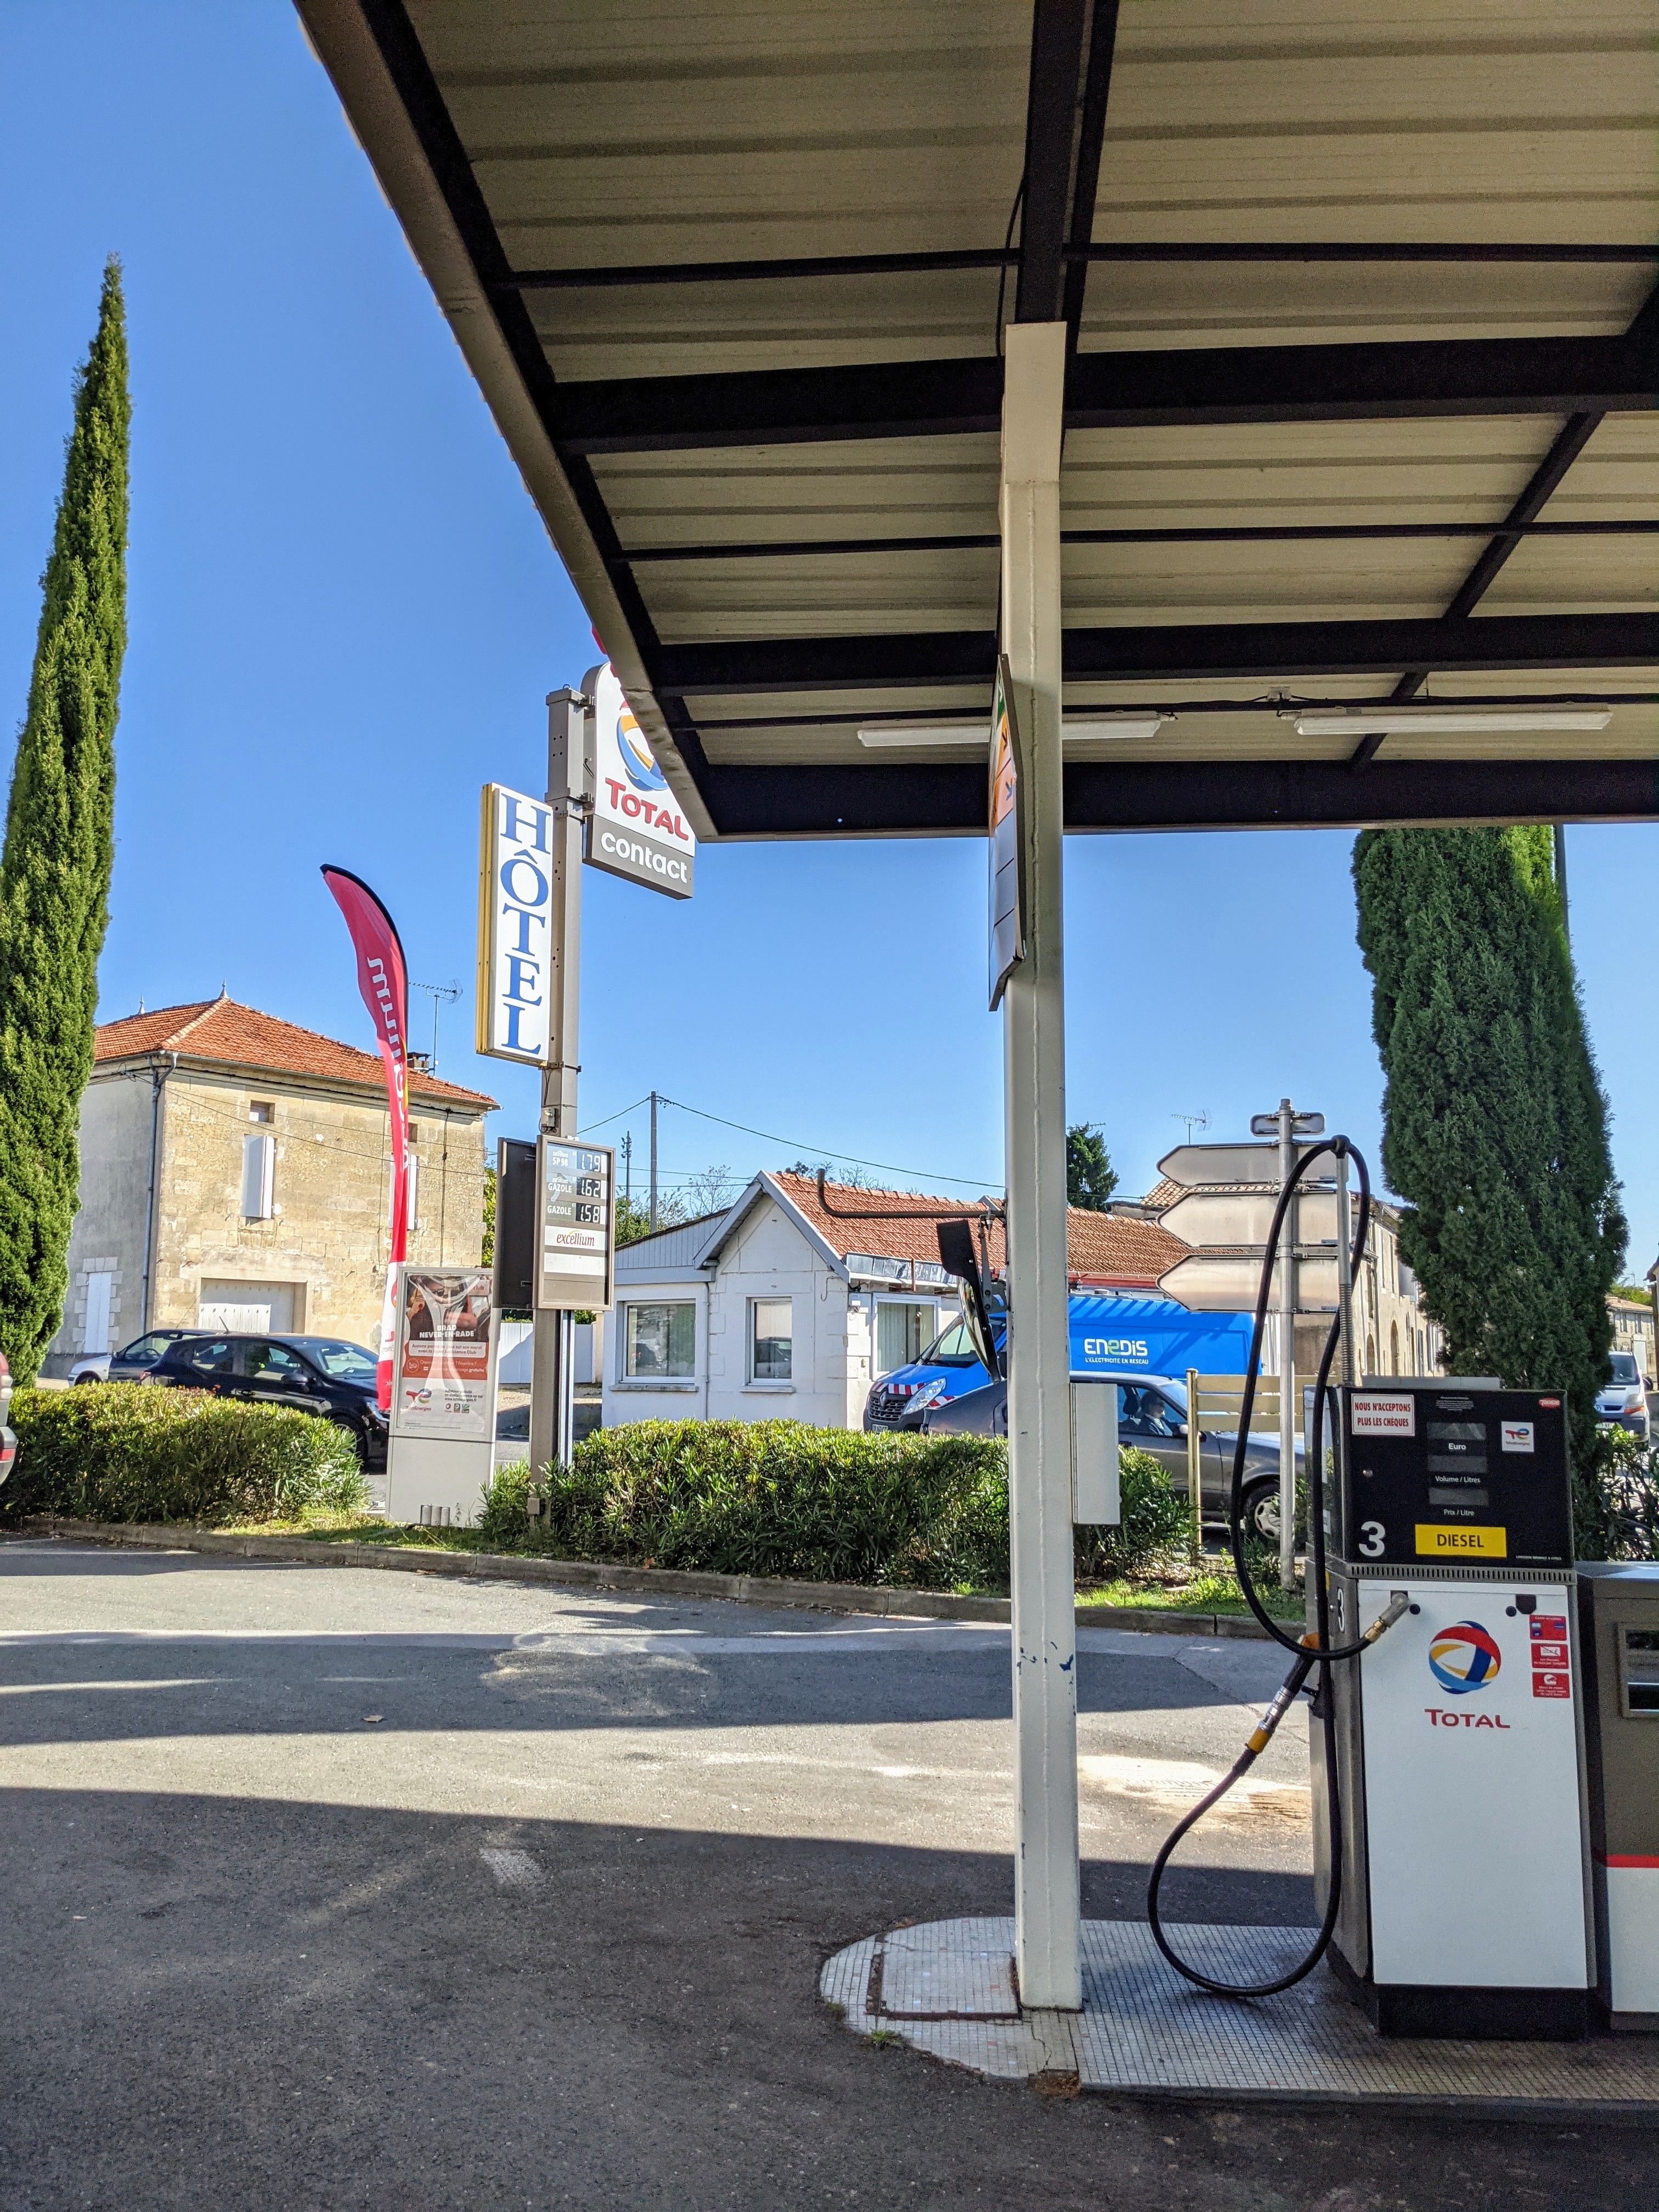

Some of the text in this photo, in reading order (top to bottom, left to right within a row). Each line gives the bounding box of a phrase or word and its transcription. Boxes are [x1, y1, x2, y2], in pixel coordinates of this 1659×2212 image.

[605, 776, 689, 842] TOTAL
[601, 832, 687, 883] contact
[500, 792, 551, 1055] HÔTEL
[548, 1182, 572, 1193] GAZOLE
[547, 1205, 572, 1215] GAZOLE
[556, 1233, 595, 1246] excellium
[1355, 1402, 1411, 1412] NOUS N'ACCEPTONS
[1357, 1417, 1372, 1426] PLUS
[1373, 1417, 1382, 1426] LES
[1359, 1521, 1485, 1557] 3 DIESEL
[1424, 1708, 1510, 1729] TOTAL
